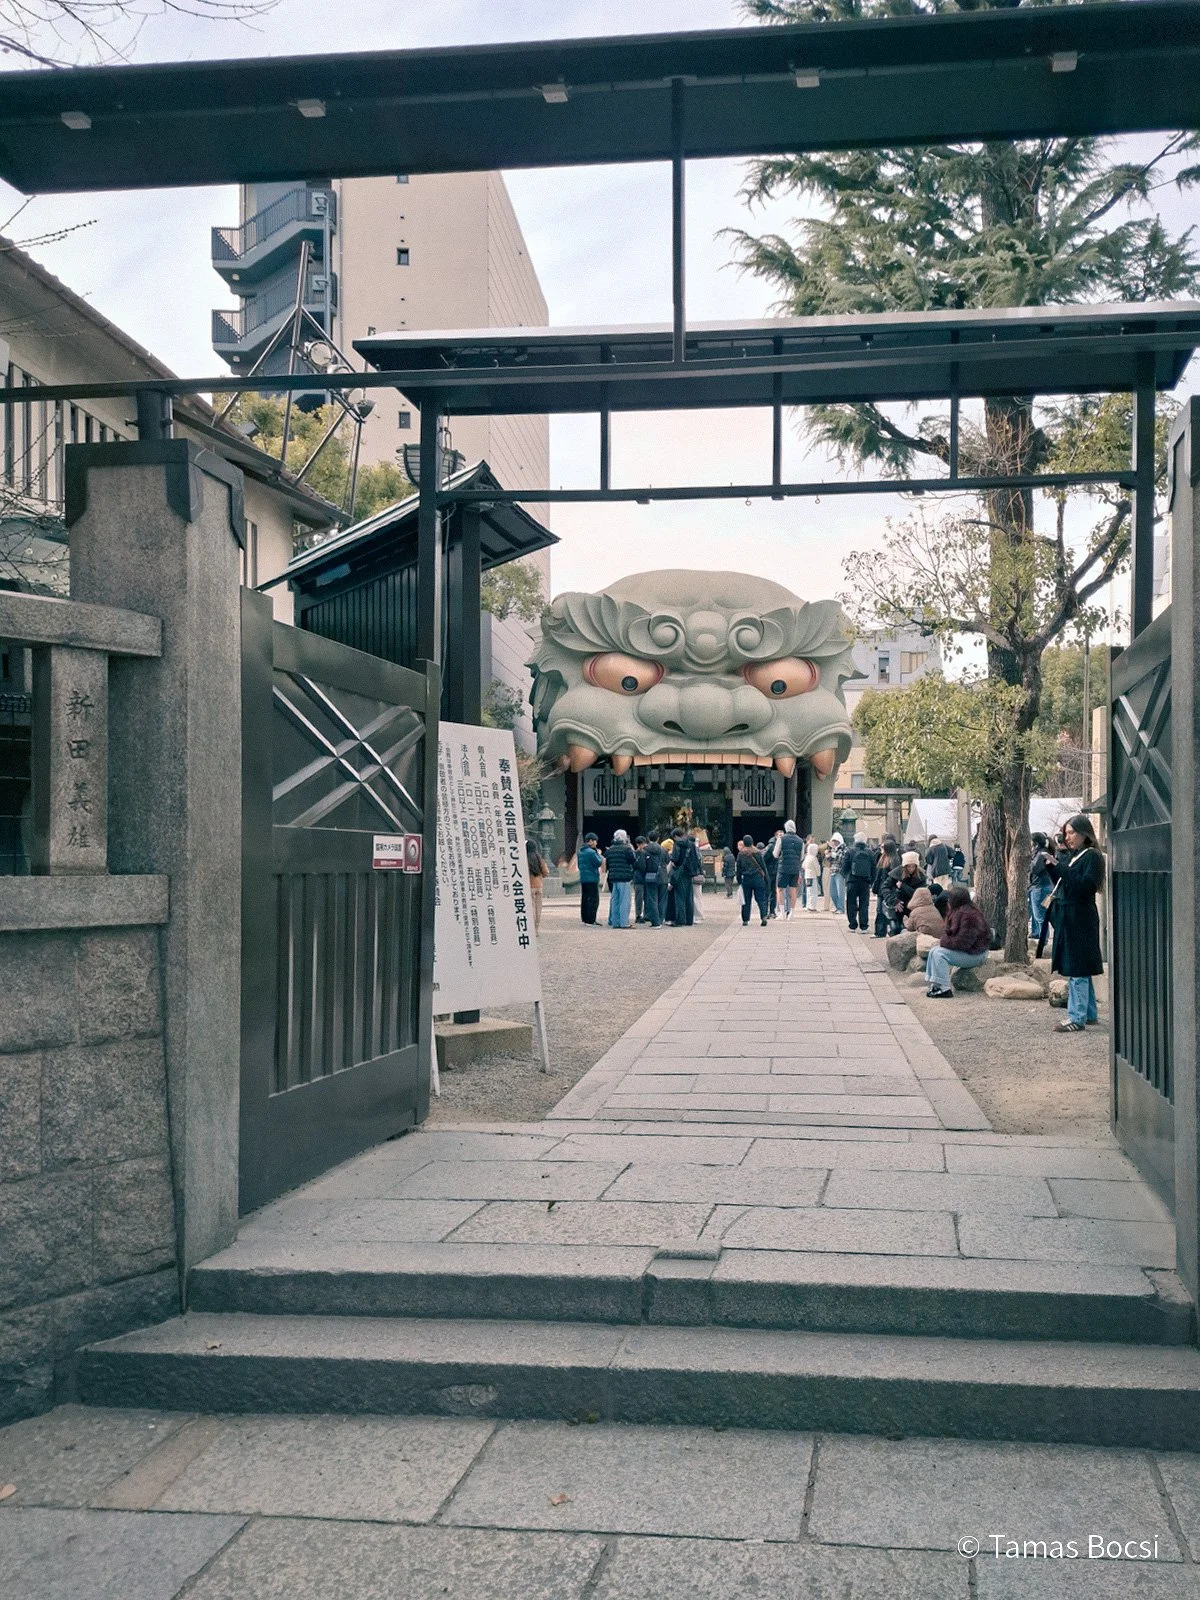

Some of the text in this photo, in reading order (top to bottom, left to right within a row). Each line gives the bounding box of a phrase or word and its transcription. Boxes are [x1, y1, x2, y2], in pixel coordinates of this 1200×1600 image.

[499, 758, 530, 950] 奉賛会会員ご入会受付中
